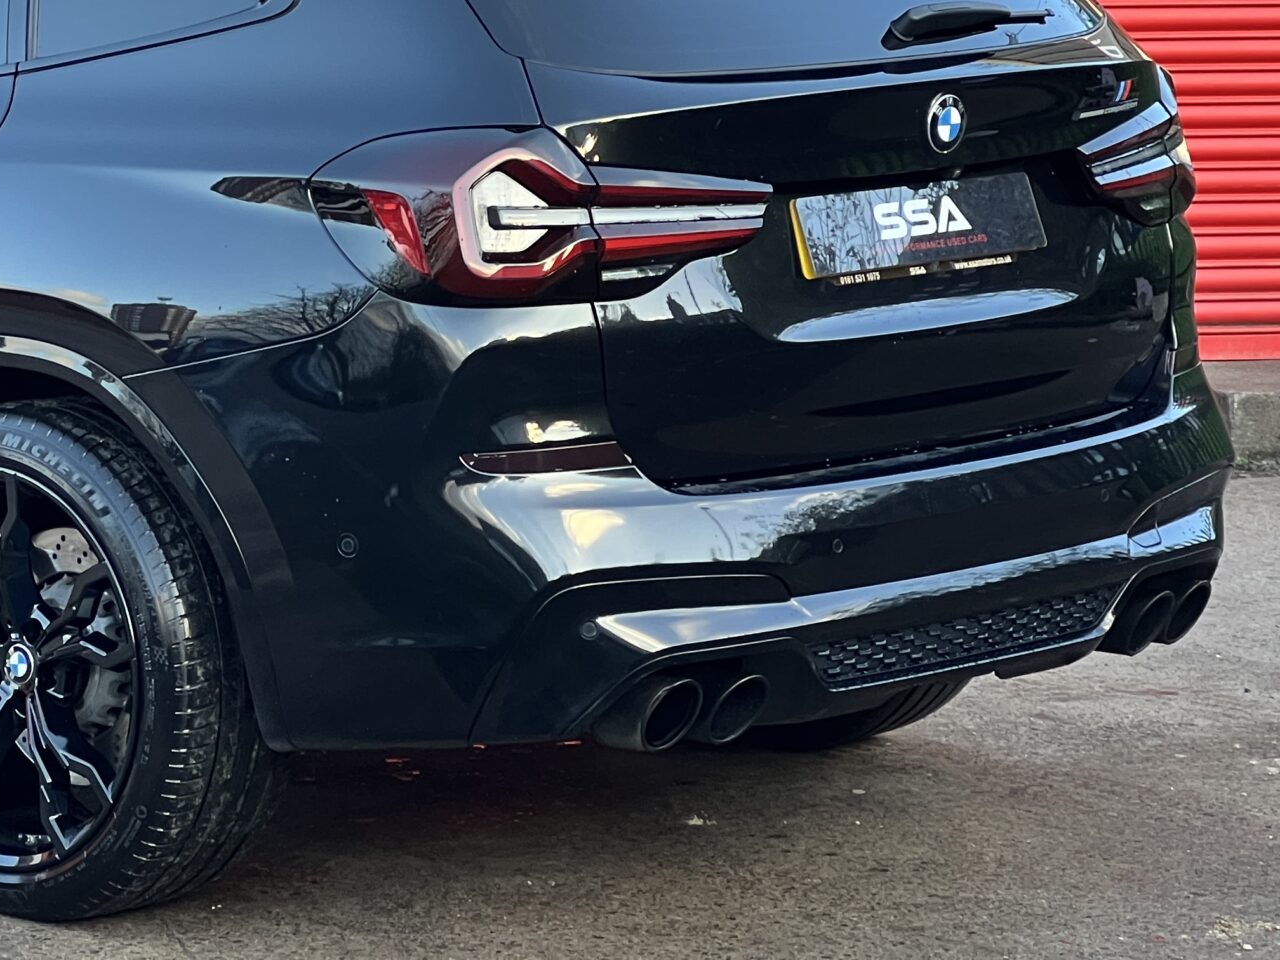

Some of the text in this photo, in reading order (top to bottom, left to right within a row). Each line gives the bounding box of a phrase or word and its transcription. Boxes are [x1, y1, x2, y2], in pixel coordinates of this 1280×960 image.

[873, 195, 973, 241] SSA
[947, 236, 967, 247] USED
[967, 233, 988, 244] CARS
[840, 275, 855, 286] 0161
[909, 266, 927, 276] SSA
[1, 432, 112, 518] MICHELIN
